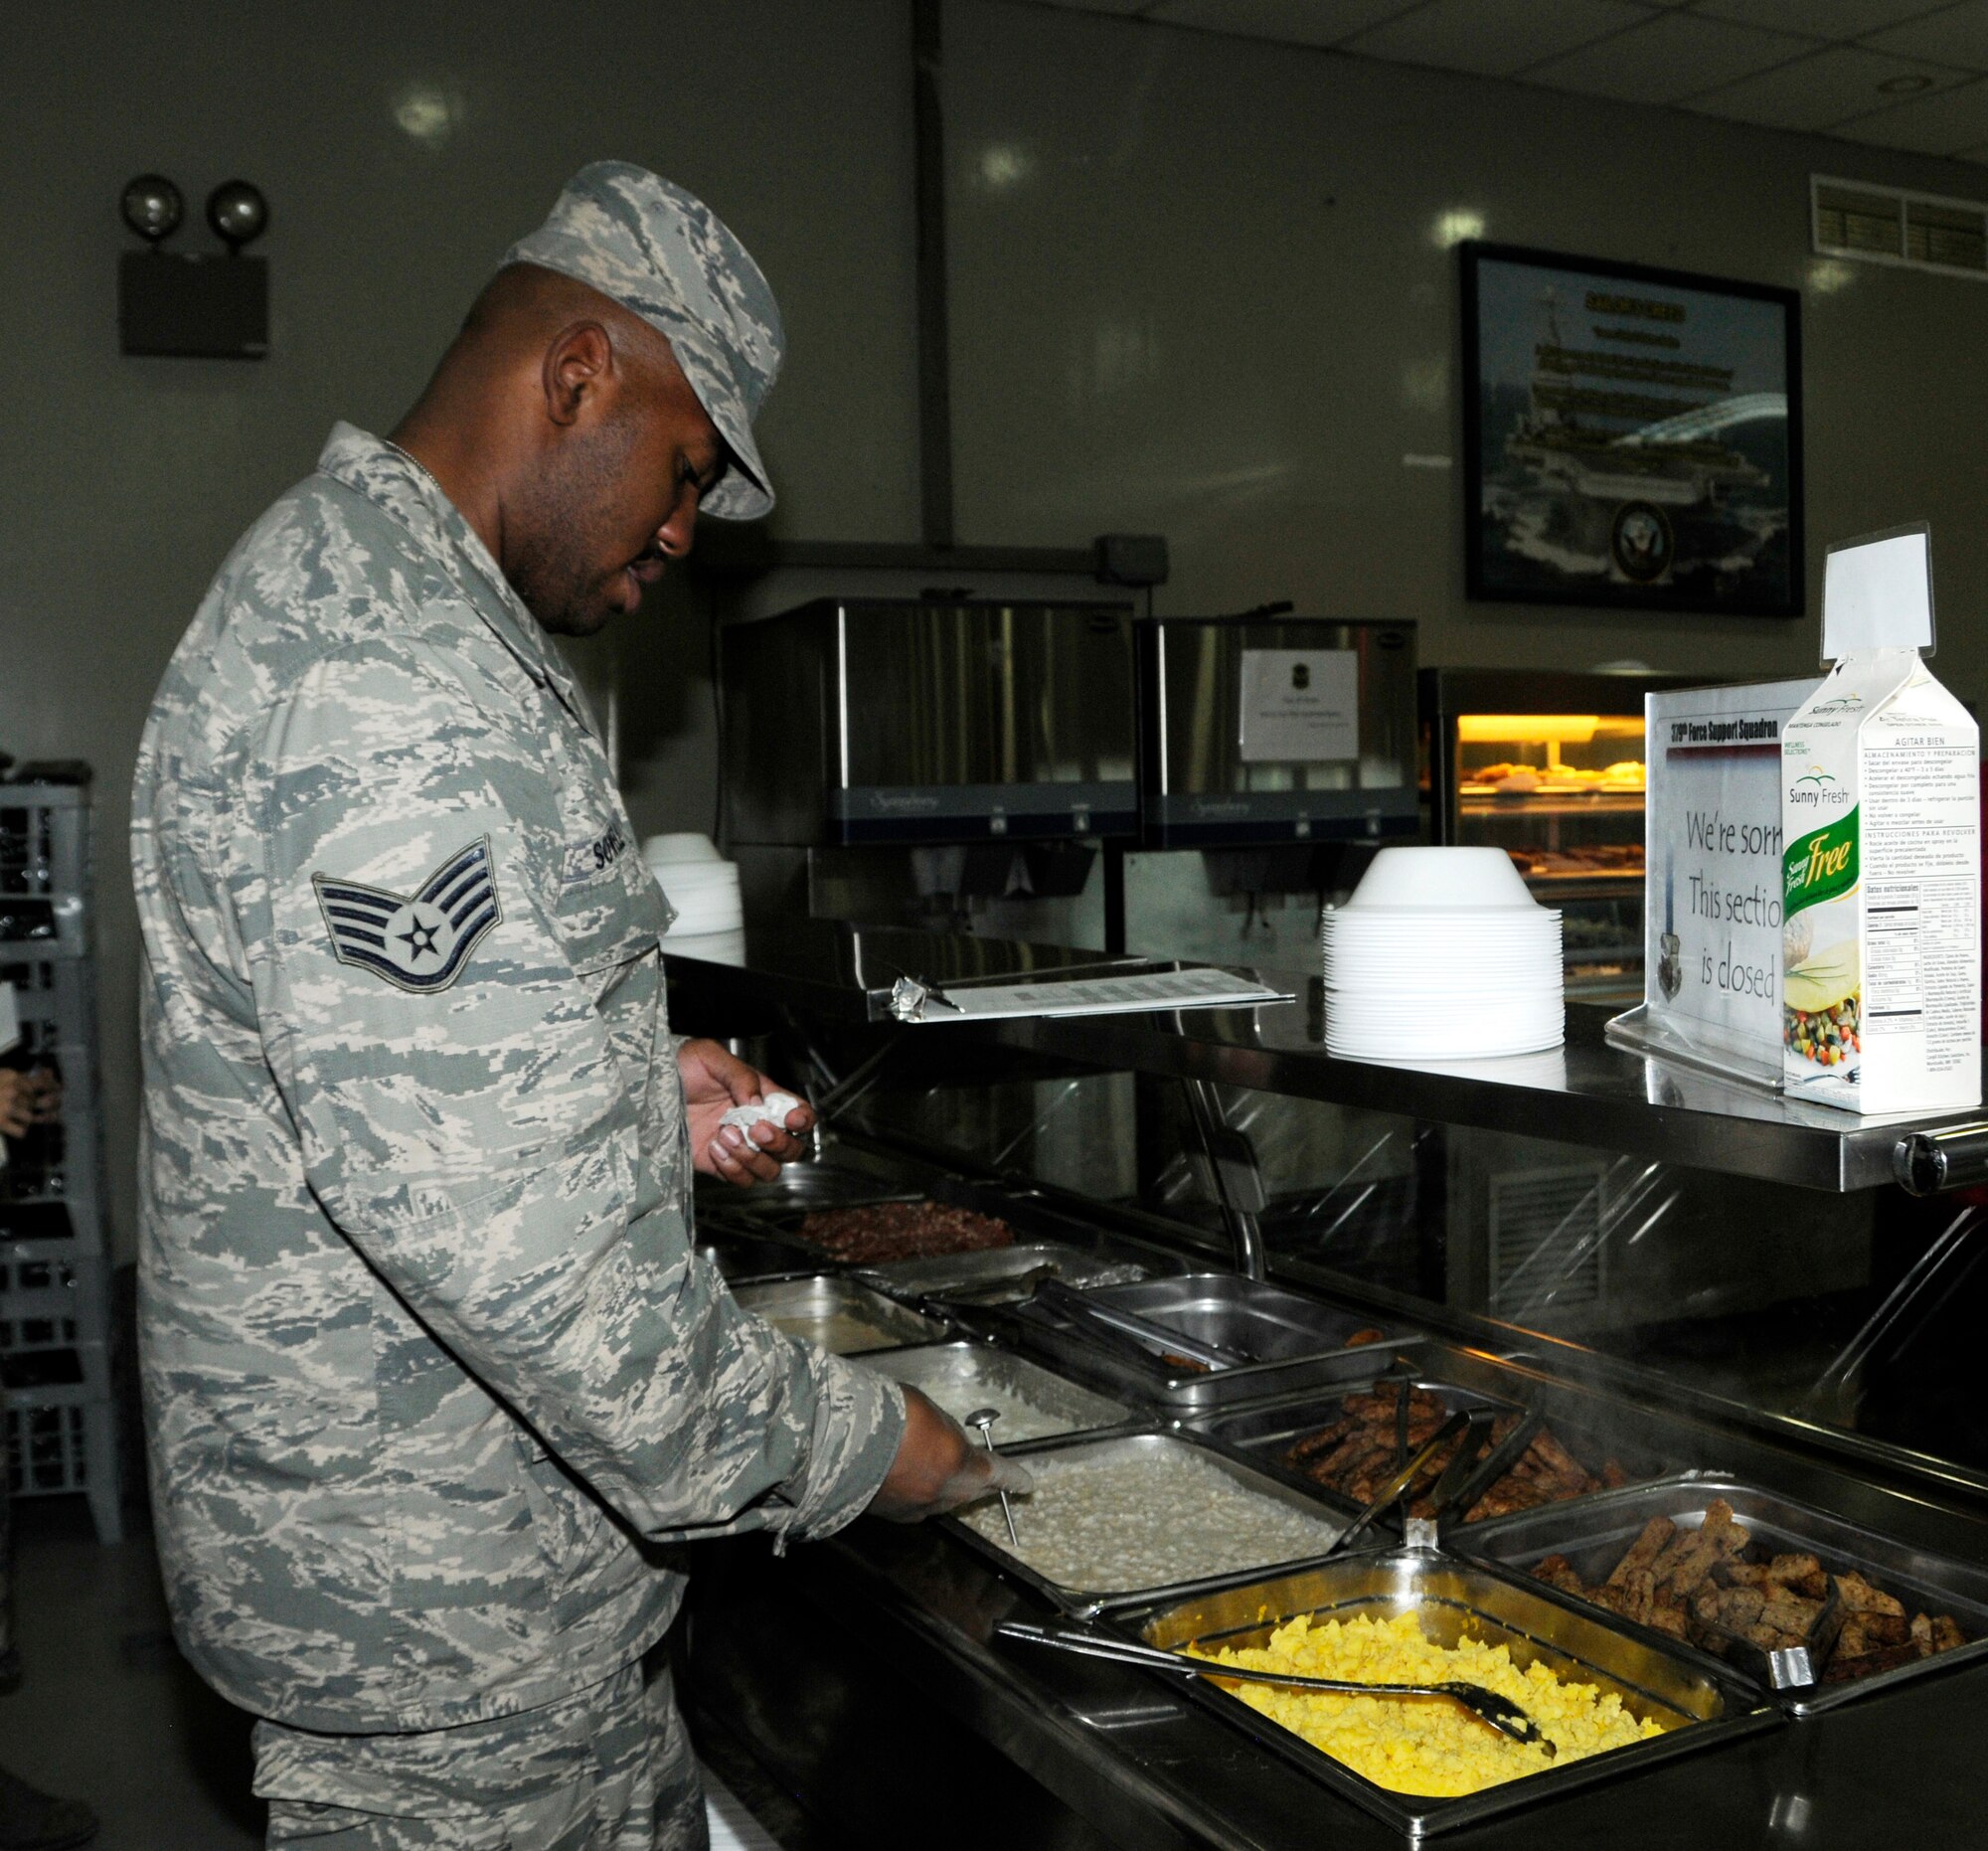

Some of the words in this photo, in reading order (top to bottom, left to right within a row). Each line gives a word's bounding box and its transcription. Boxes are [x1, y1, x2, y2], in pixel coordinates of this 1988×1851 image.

[1688, 723, 1707, 742] Force
[1709, 721, 1738, 743] Support
[1739, 719, 1778, 742] Squadron
[1789, 788, 1819, 807] Sunny
[1822, 788, 1846, 803] Fresh
[1687, 810, 1736, 852] We're
[1741, 824, 1782, 855] sorr
[1805, 832, 1853, 889] Free
[1689, 868, 1722, 919] This
[1726, 885, 1781, 928] sectio
[1702, 946, 1713, 985] is
[1718, 939, 1774, 1006] closed
